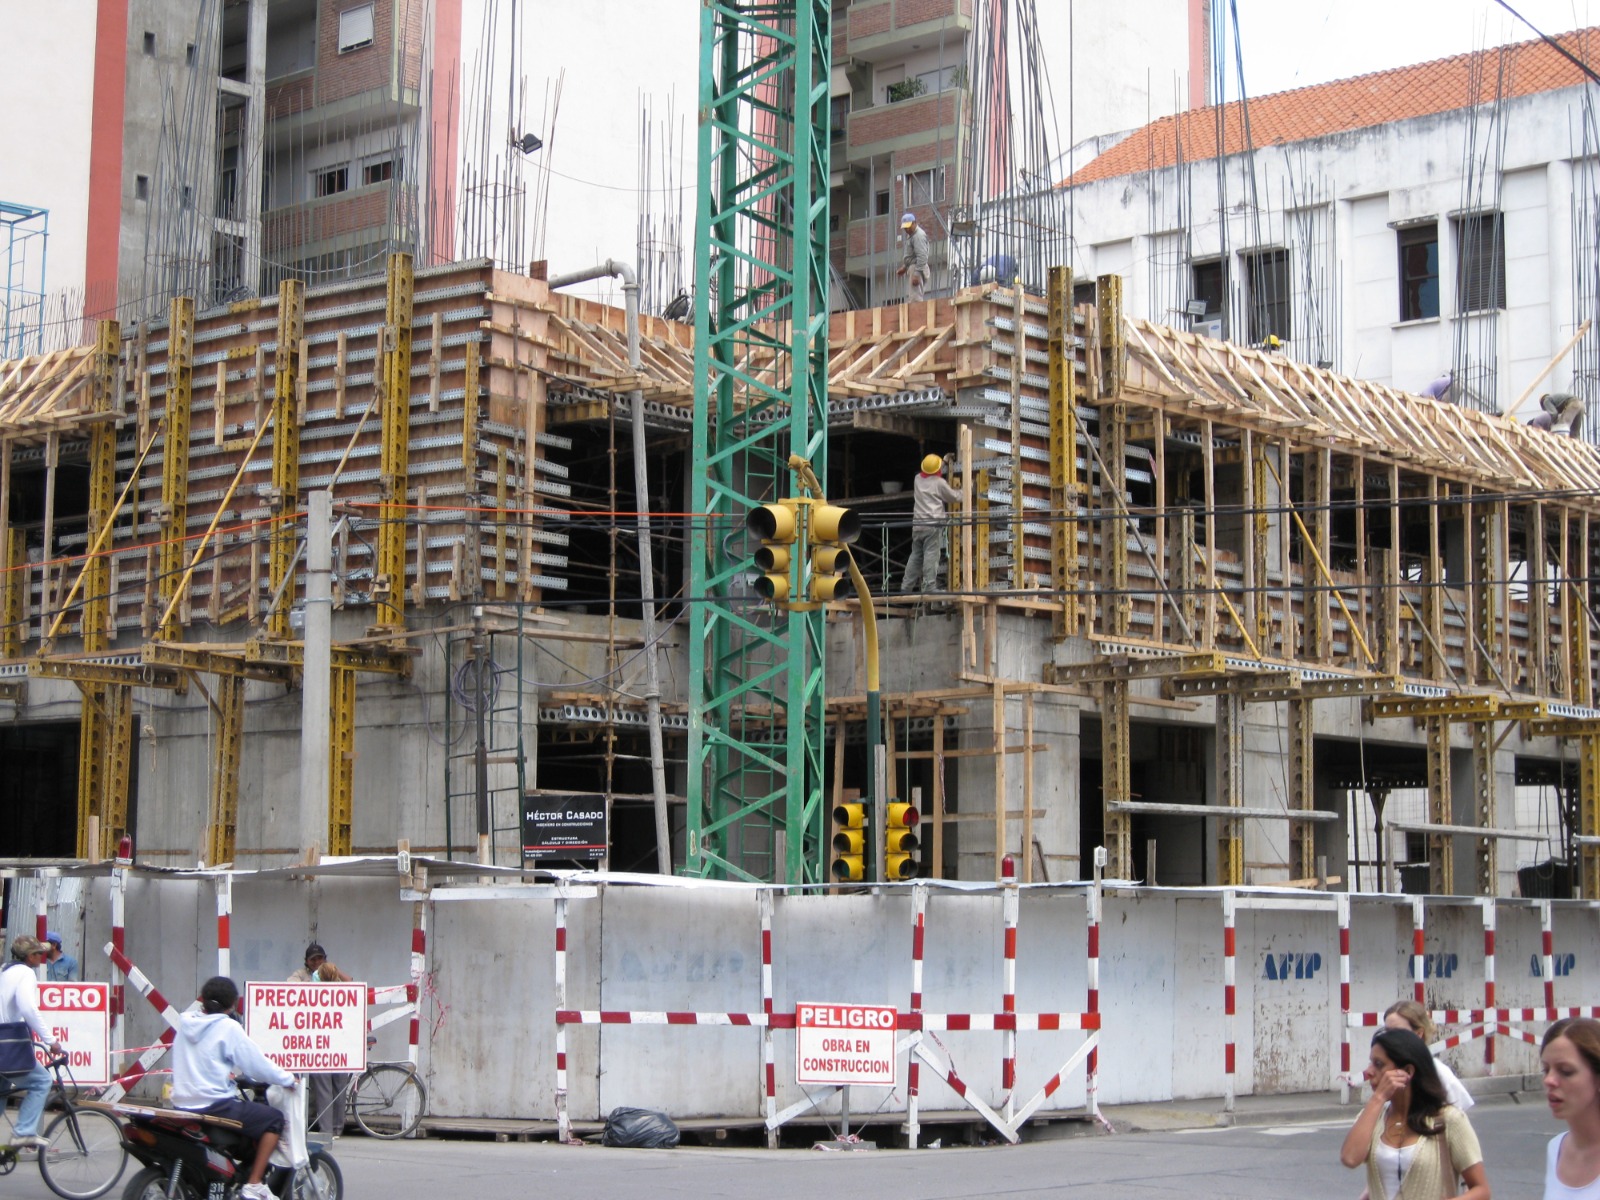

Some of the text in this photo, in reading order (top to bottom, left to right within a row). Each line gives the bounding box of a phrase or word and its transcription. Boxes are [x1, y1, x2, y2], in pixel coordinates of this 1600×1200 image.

[526, 810, 604, 820] HÉCTOR CASADO
[255, 989, 358, 1007] PRECAUCION
[268, 1012, 343, 1030] AL GIRAR
[800, 1007, 894, 1028] PELIGRO
[282, 1035, 330, 1050] OBRA EN
[822, 1038, 870, 1053] OBRA EN
[803, 1058, 889, 1074] CONSTRUCCION
